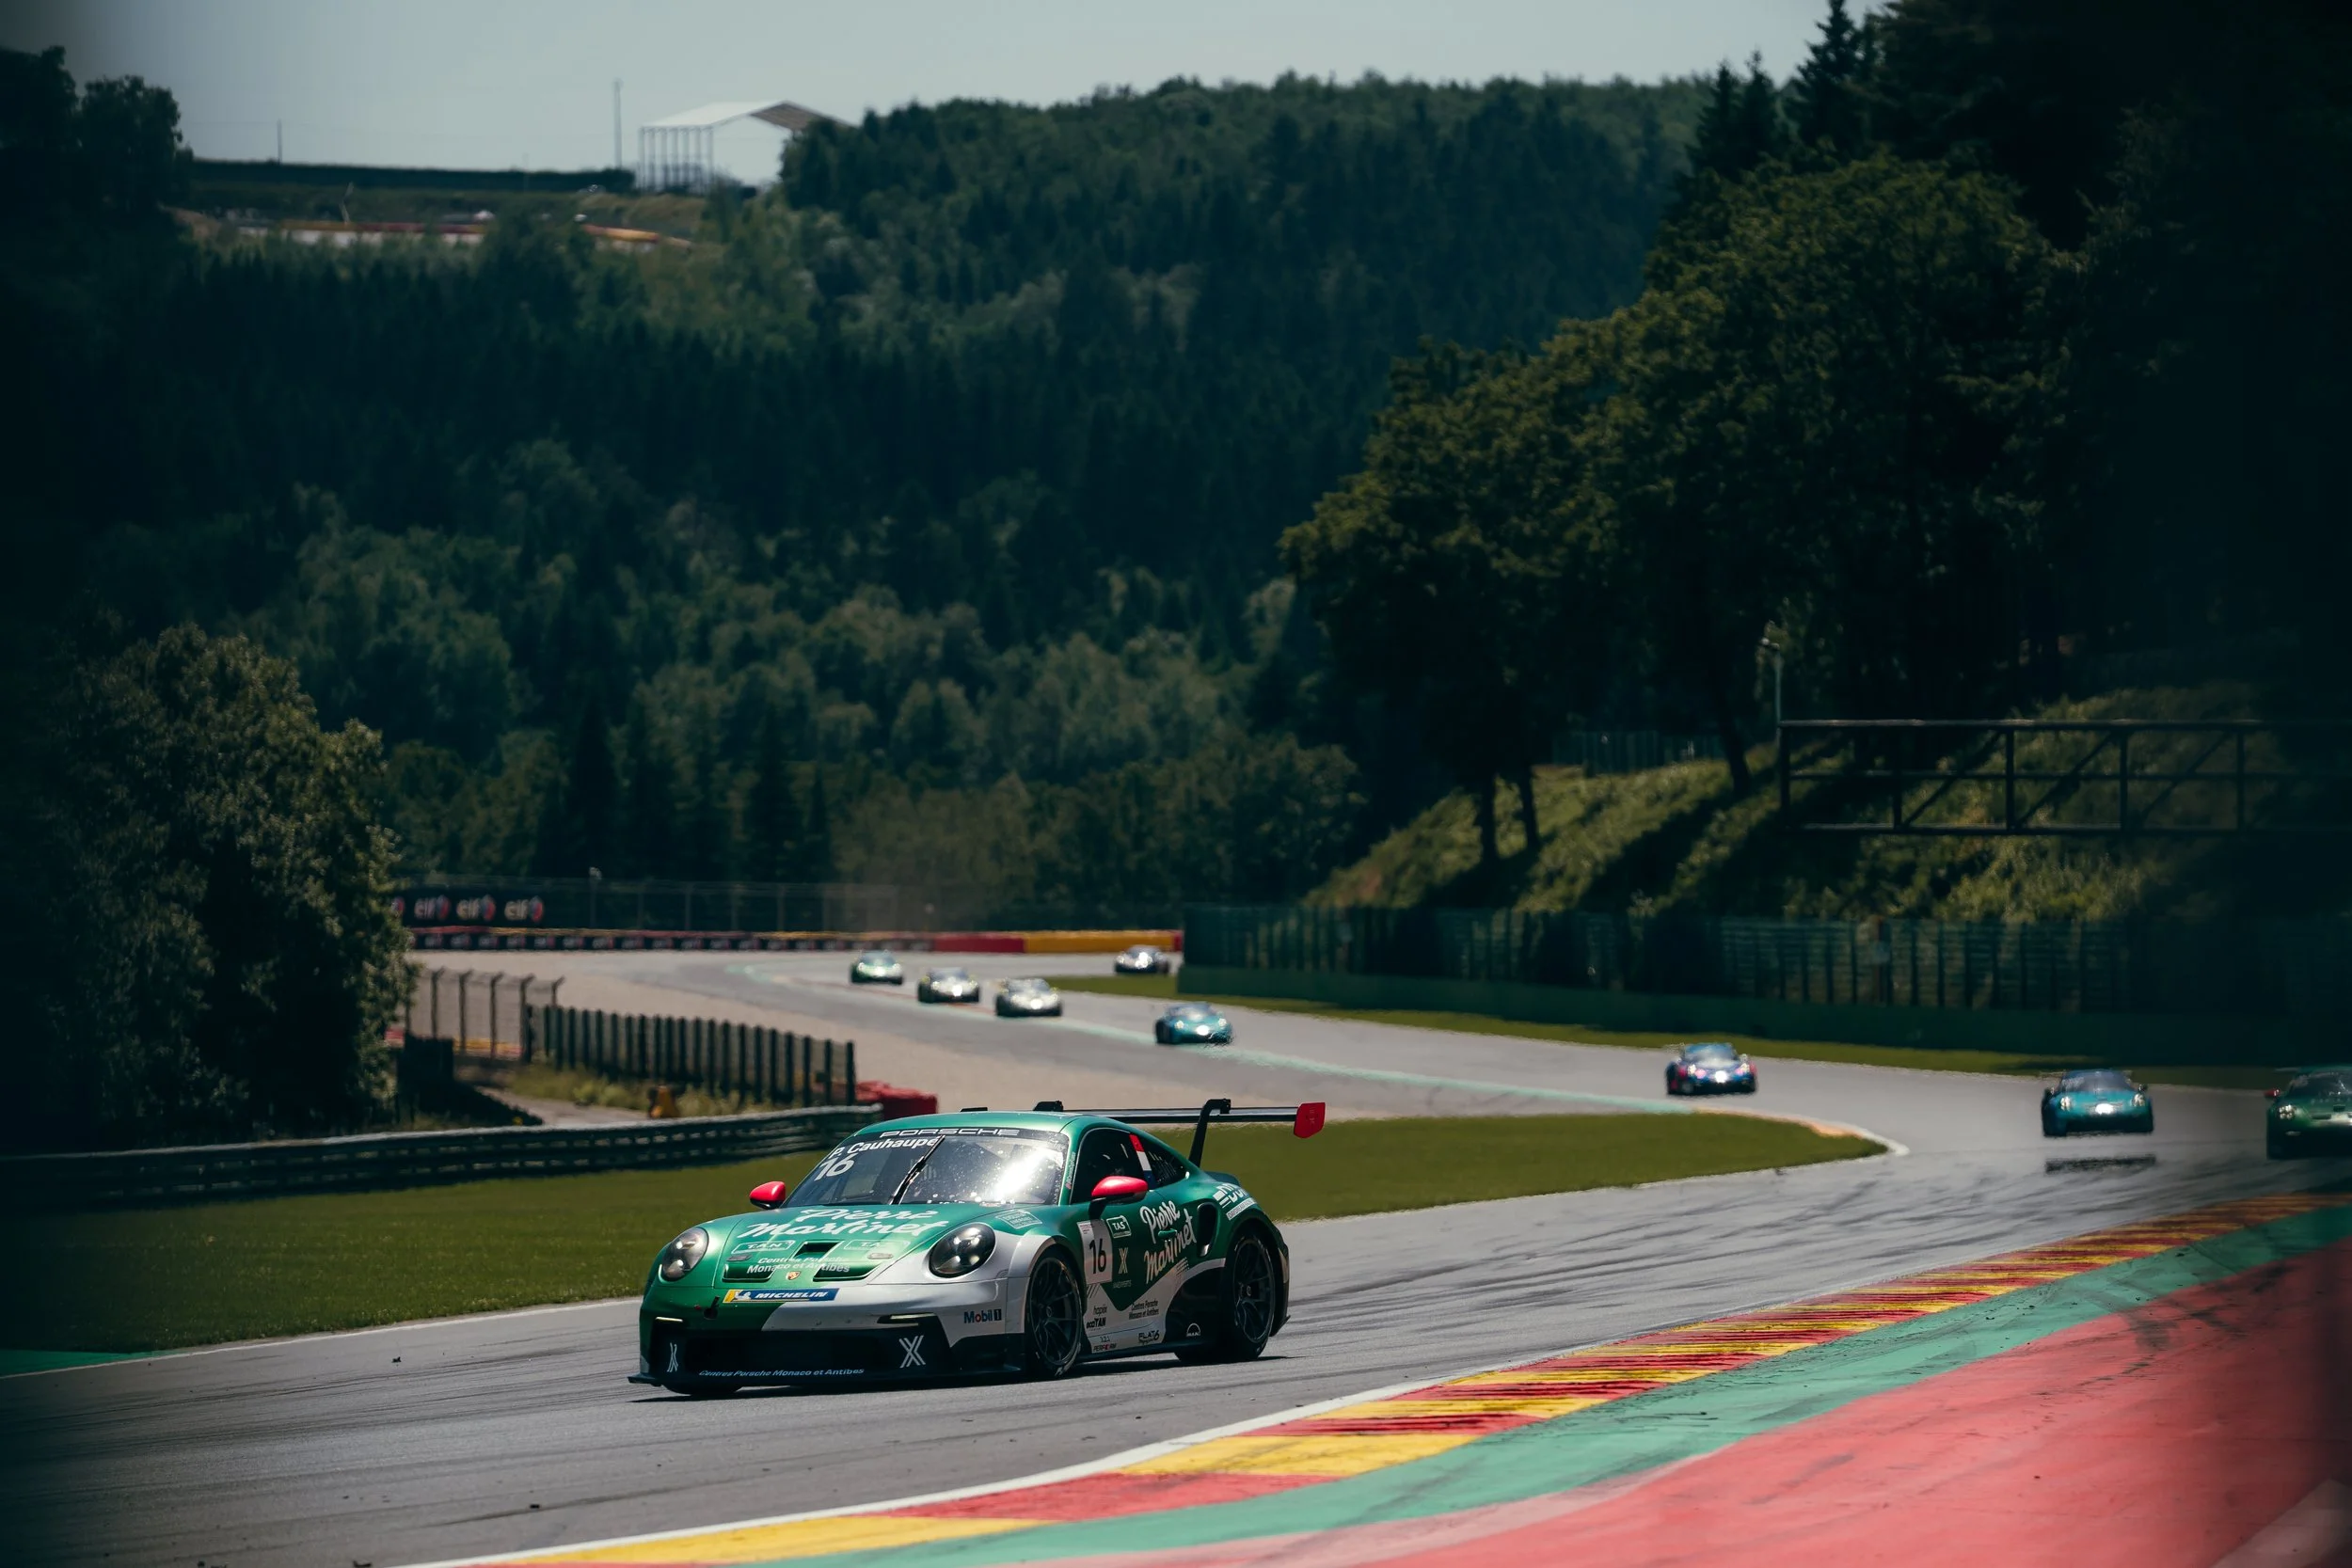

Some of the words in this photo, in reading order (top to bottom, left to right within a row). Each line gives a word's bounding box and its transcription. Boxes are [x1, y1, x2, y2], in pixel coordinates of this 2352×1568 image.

[456, 898, 480, 920] elf
[504, 898, 529, 920] elf
[880, 1128, 1021, 1138] PORSCHE
[814, 1153, 859, 1181] 16
[737, 1219, 949, 1239] Martinet
[1139, 1200, 1181, 1243] Pierre
[1089, 1239, 1107, 1275] 16
[1144, 1209, 1198, 1285] Martinet
[747, 1263, 793, 1275] Monaco
[806, 1262, 850, 1273] Antibes
[755, 1291, 829, 1299] MICHELIN
[963, 1310, 993, 1323] Mobil
